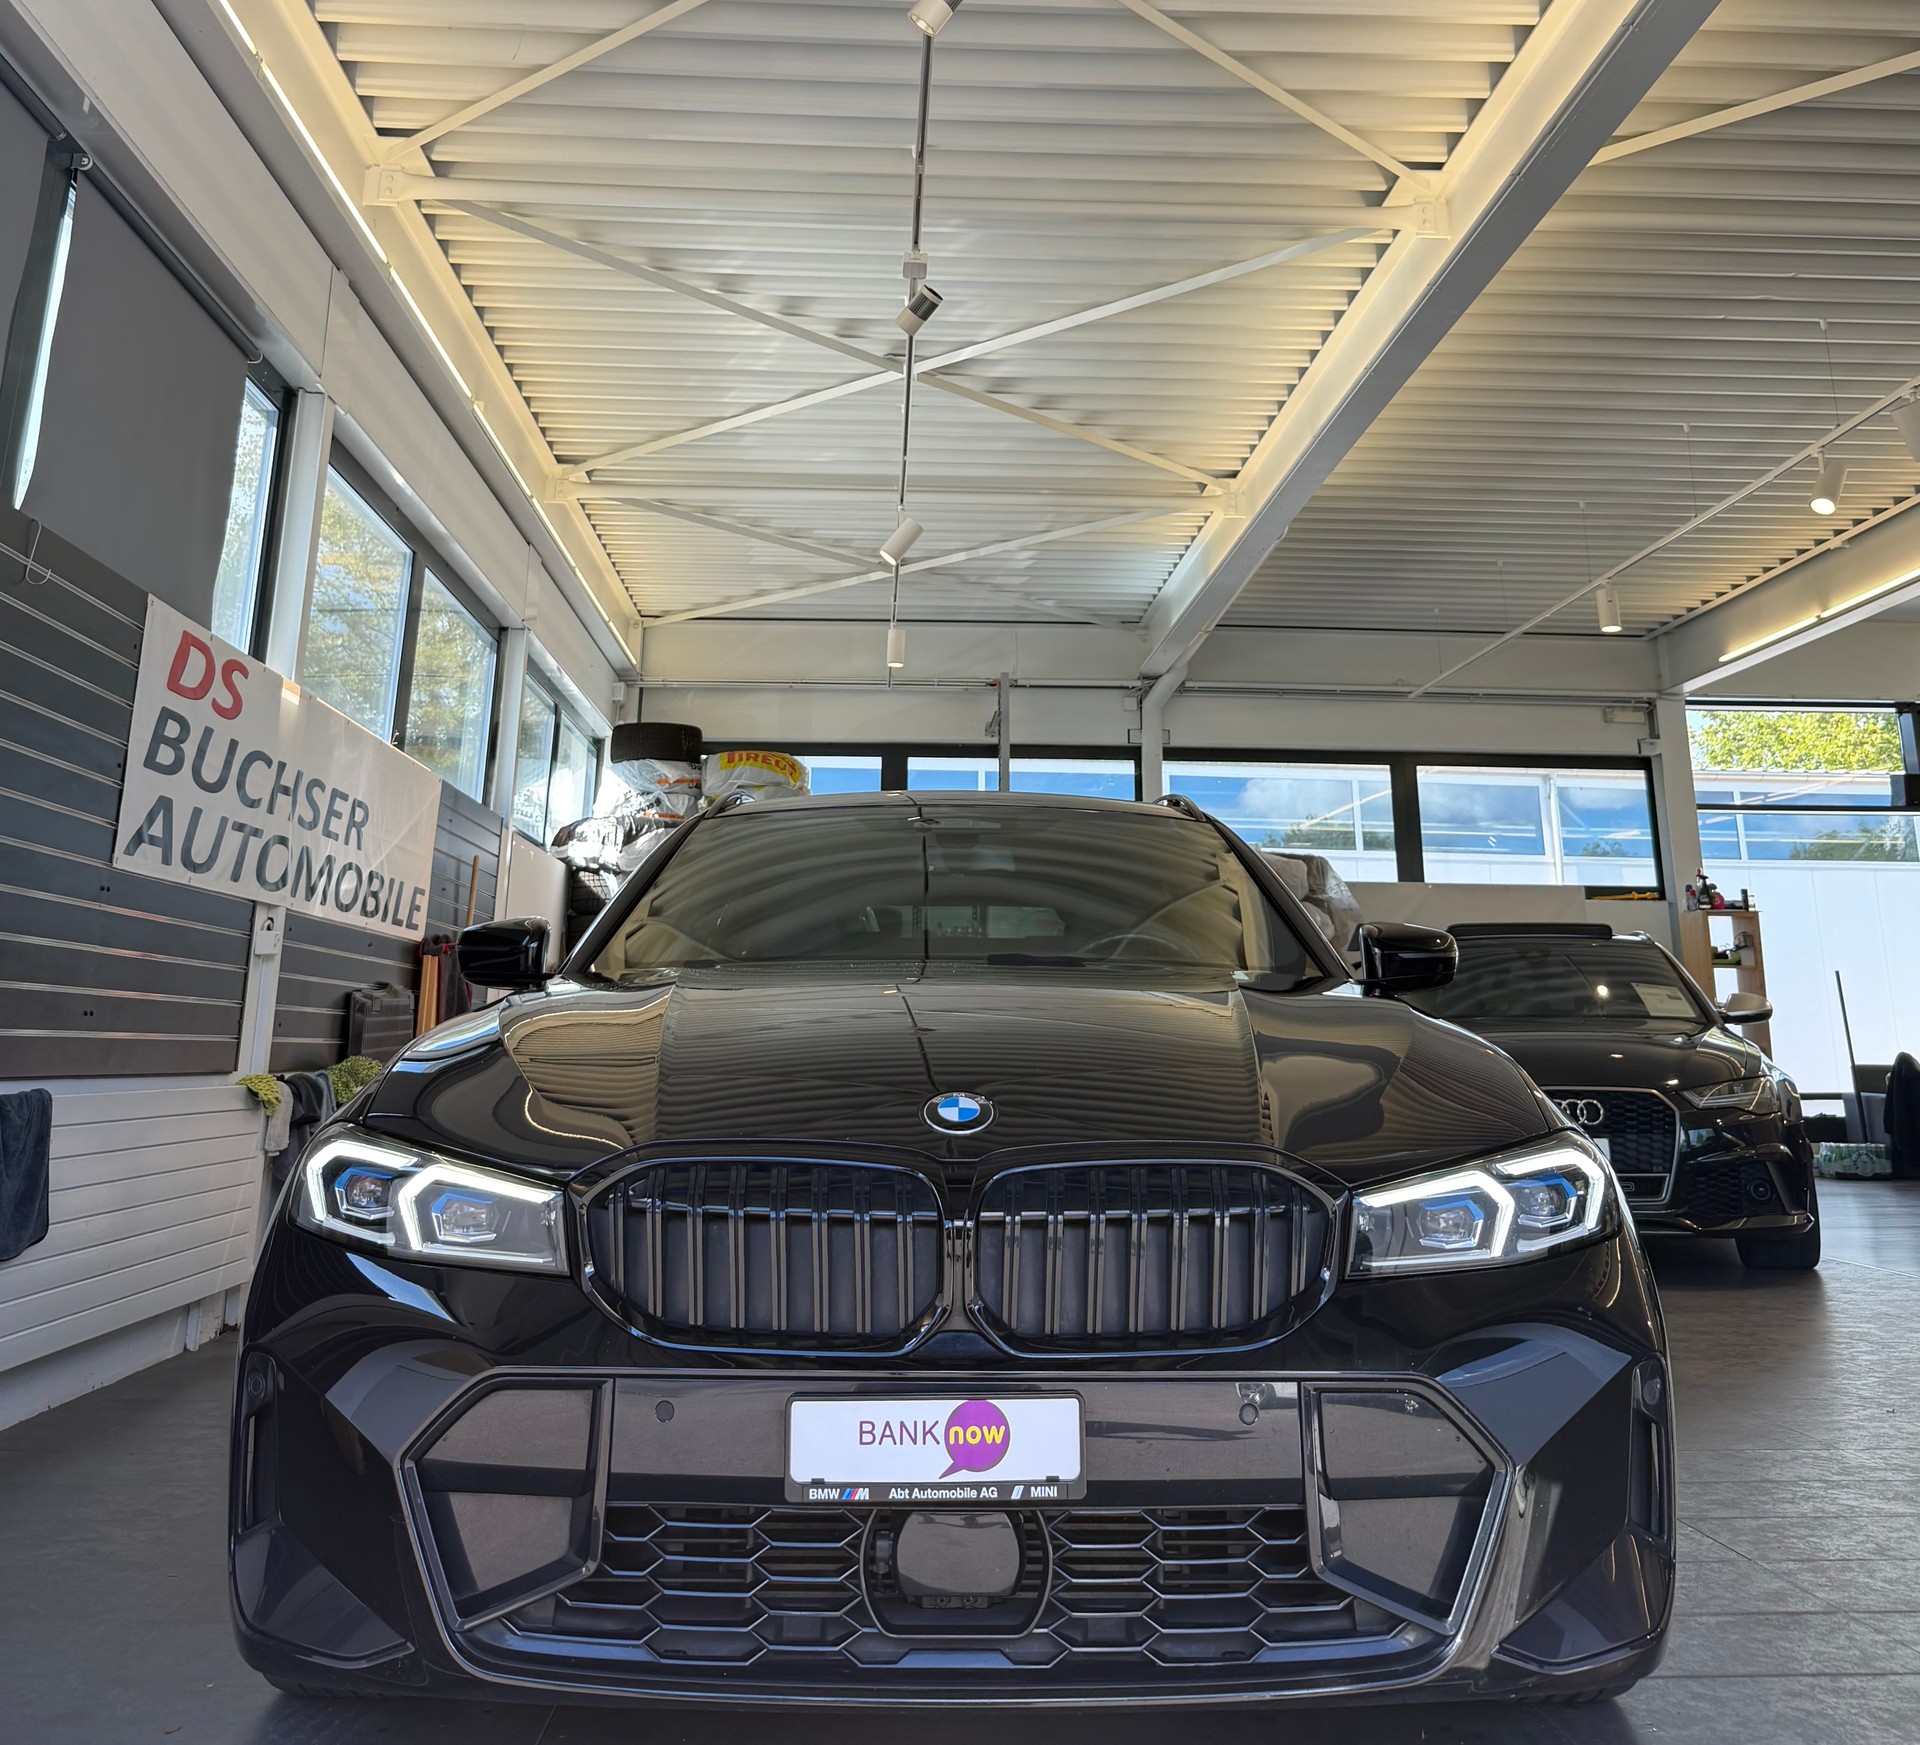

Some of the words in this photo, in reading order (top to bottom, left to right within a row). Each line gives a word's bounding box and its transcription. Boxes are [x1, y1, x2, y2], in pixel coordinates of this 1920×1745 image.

[166, 630, 250, 720] DS
[143, 705, 370, 851] BUCHSER
[123, 795, 426, 932] AUTOMOBILE
[859, 1420, 941, 1446] BANK
[949, 1425, 1006, 1445] now
[809, 1488, 840, 1500] BMW
[888, 1487, 910, 1499] Abt
[911, 1487, 978, 1499] Automobile
[979, 1487, 998, 1498] AG
[1030, 1486, 1058, 1498] MINI
